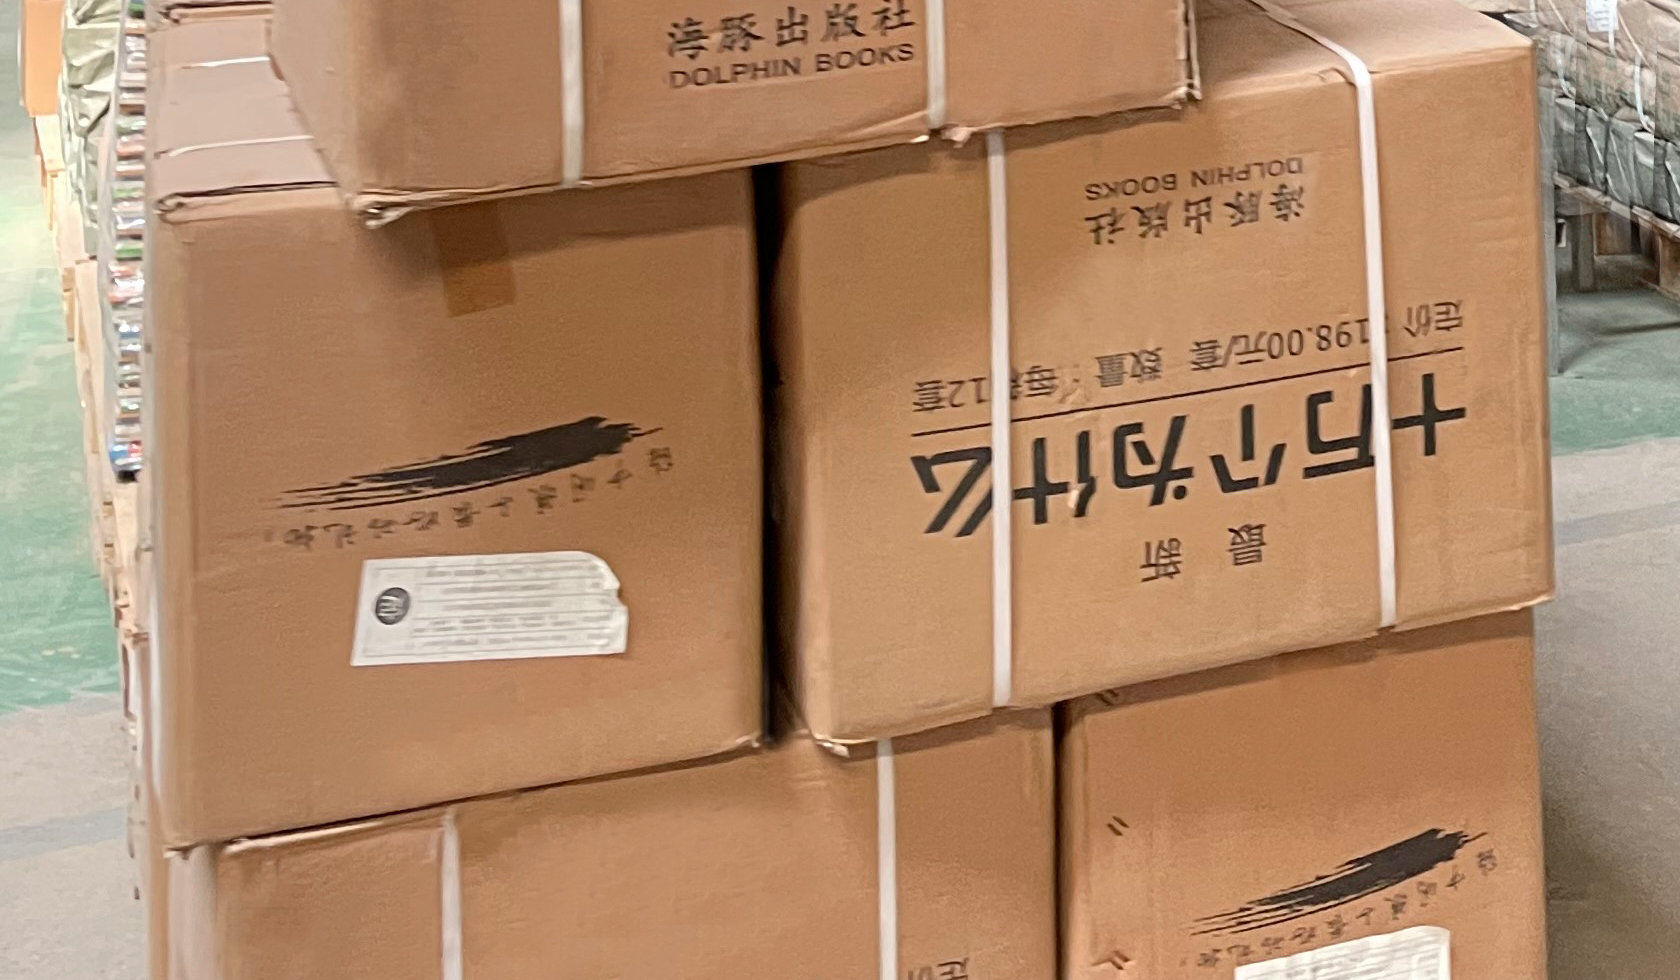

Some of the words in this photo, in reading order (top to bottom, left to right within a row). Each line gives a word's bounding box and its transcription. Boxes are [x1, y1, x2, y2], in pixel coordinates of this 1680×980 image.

[667, 57, 802, 91] DOLPHIN
[814, 42, 917, 75] BOOKS
[1084, 171, 1178, 202] BOOKS
[1189, 155, 1304, 190] DOLPHIN
[1084, 182, 1306, 246] 海豚出版社
[910, 372, 1467, 539] 十万个为什么
[1139, 522, 1268, 584] 最新
